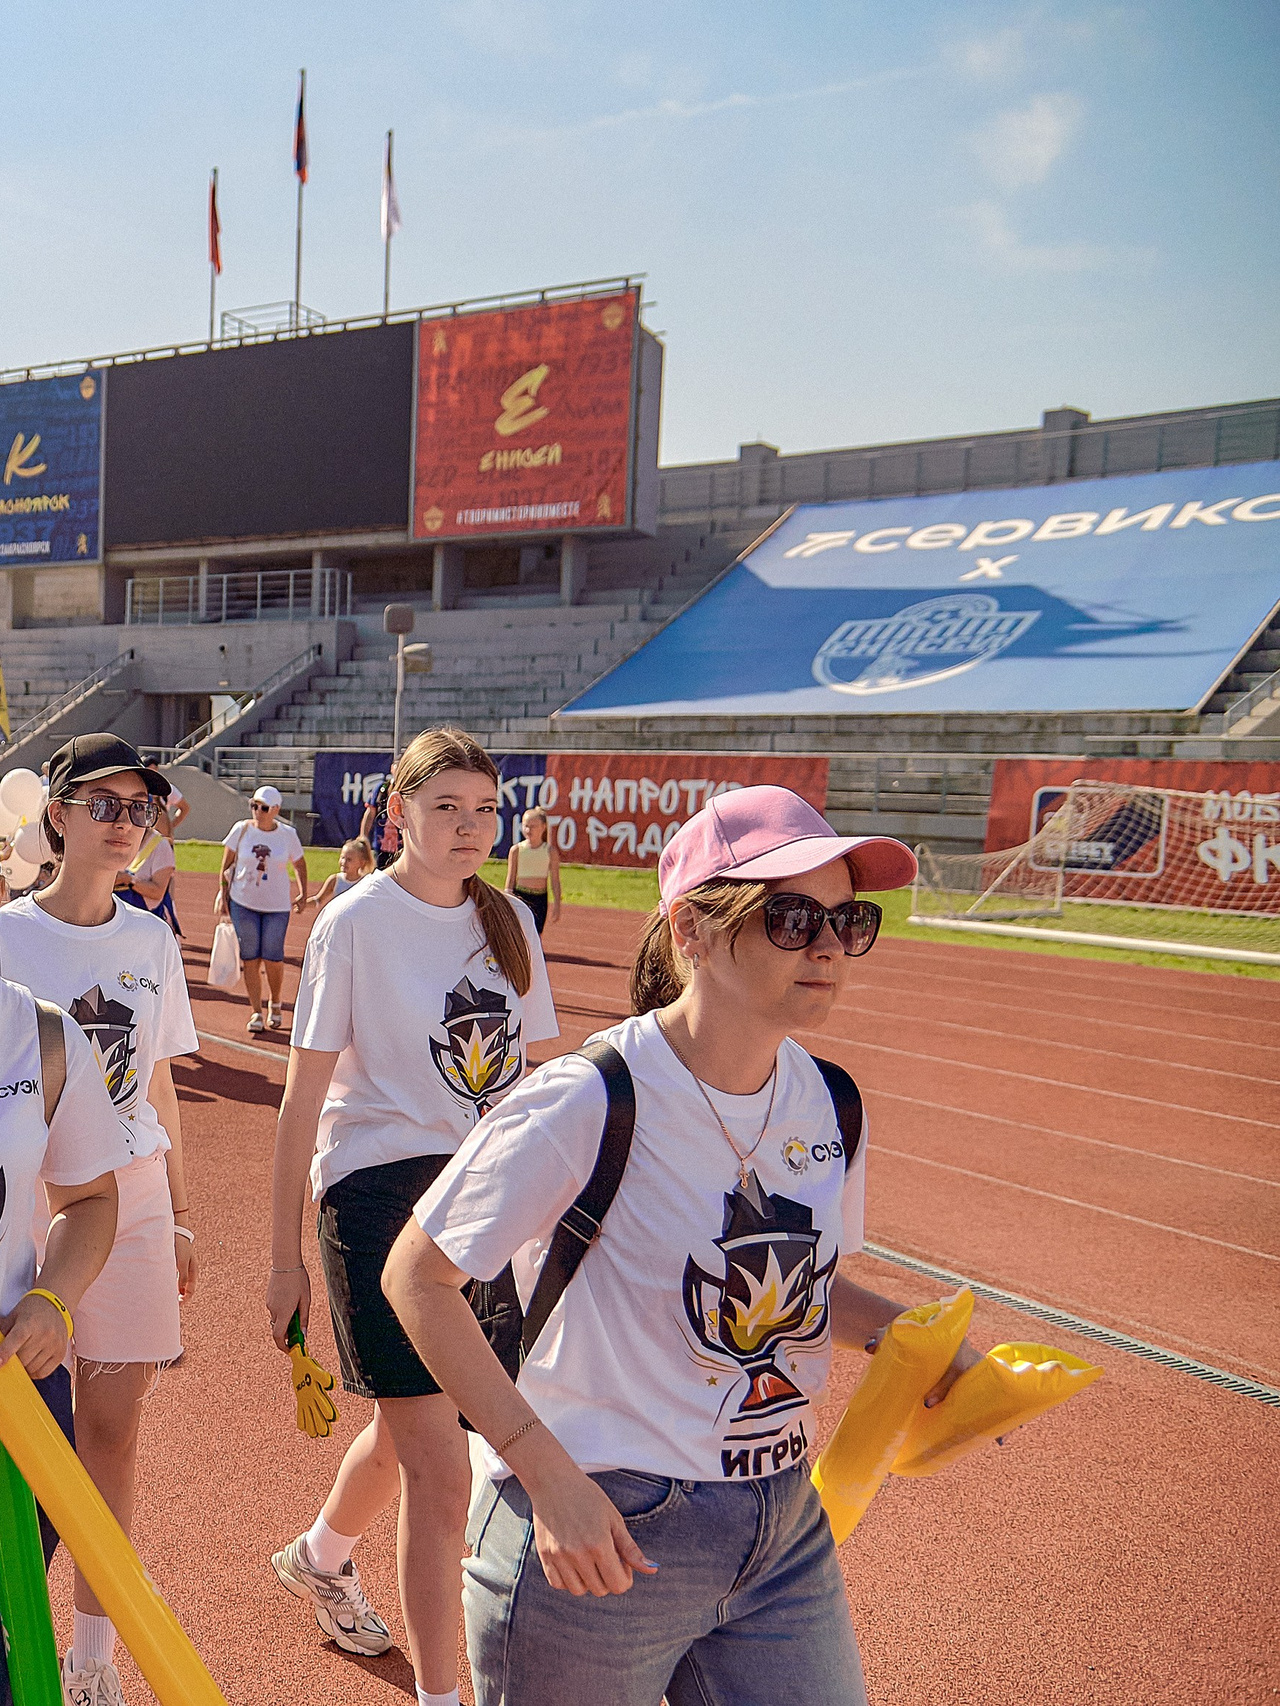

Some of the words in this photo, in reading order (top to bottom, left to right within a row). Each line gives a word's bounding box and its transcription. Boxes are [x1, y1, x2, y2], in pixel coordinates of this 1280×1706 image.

[497, 774, 559, 810] КТО
[569, 776, 745, 816] НАПРОТИ
[811, 1139, 844, 1163] СУЭ
[721, 1419, 808, 1478] ИГРЫ
